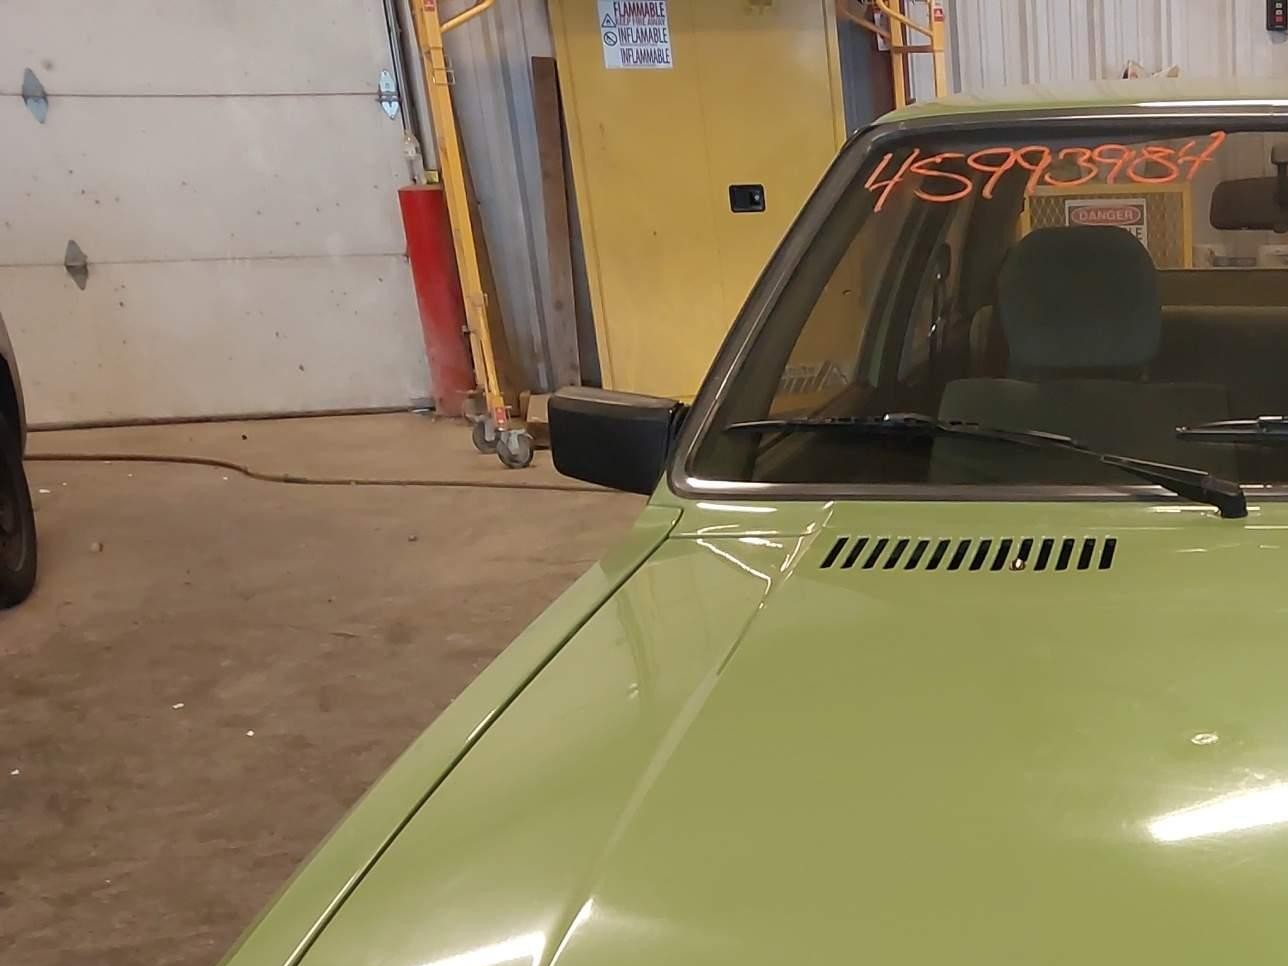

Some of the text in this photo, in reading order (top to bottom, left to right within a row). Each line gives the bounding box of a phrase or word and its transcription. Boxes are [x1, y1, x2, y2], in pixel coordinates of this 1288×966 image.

[613, 2, 665, 17] FLAMMABLE
[617, 27, 668, 44] INFLAMABLE
[620, 48, 670, 64] INFLAMMABLE
[865, 130, 1227, 213] 45993984
[1079, 210, 1134, 221] DANGER
